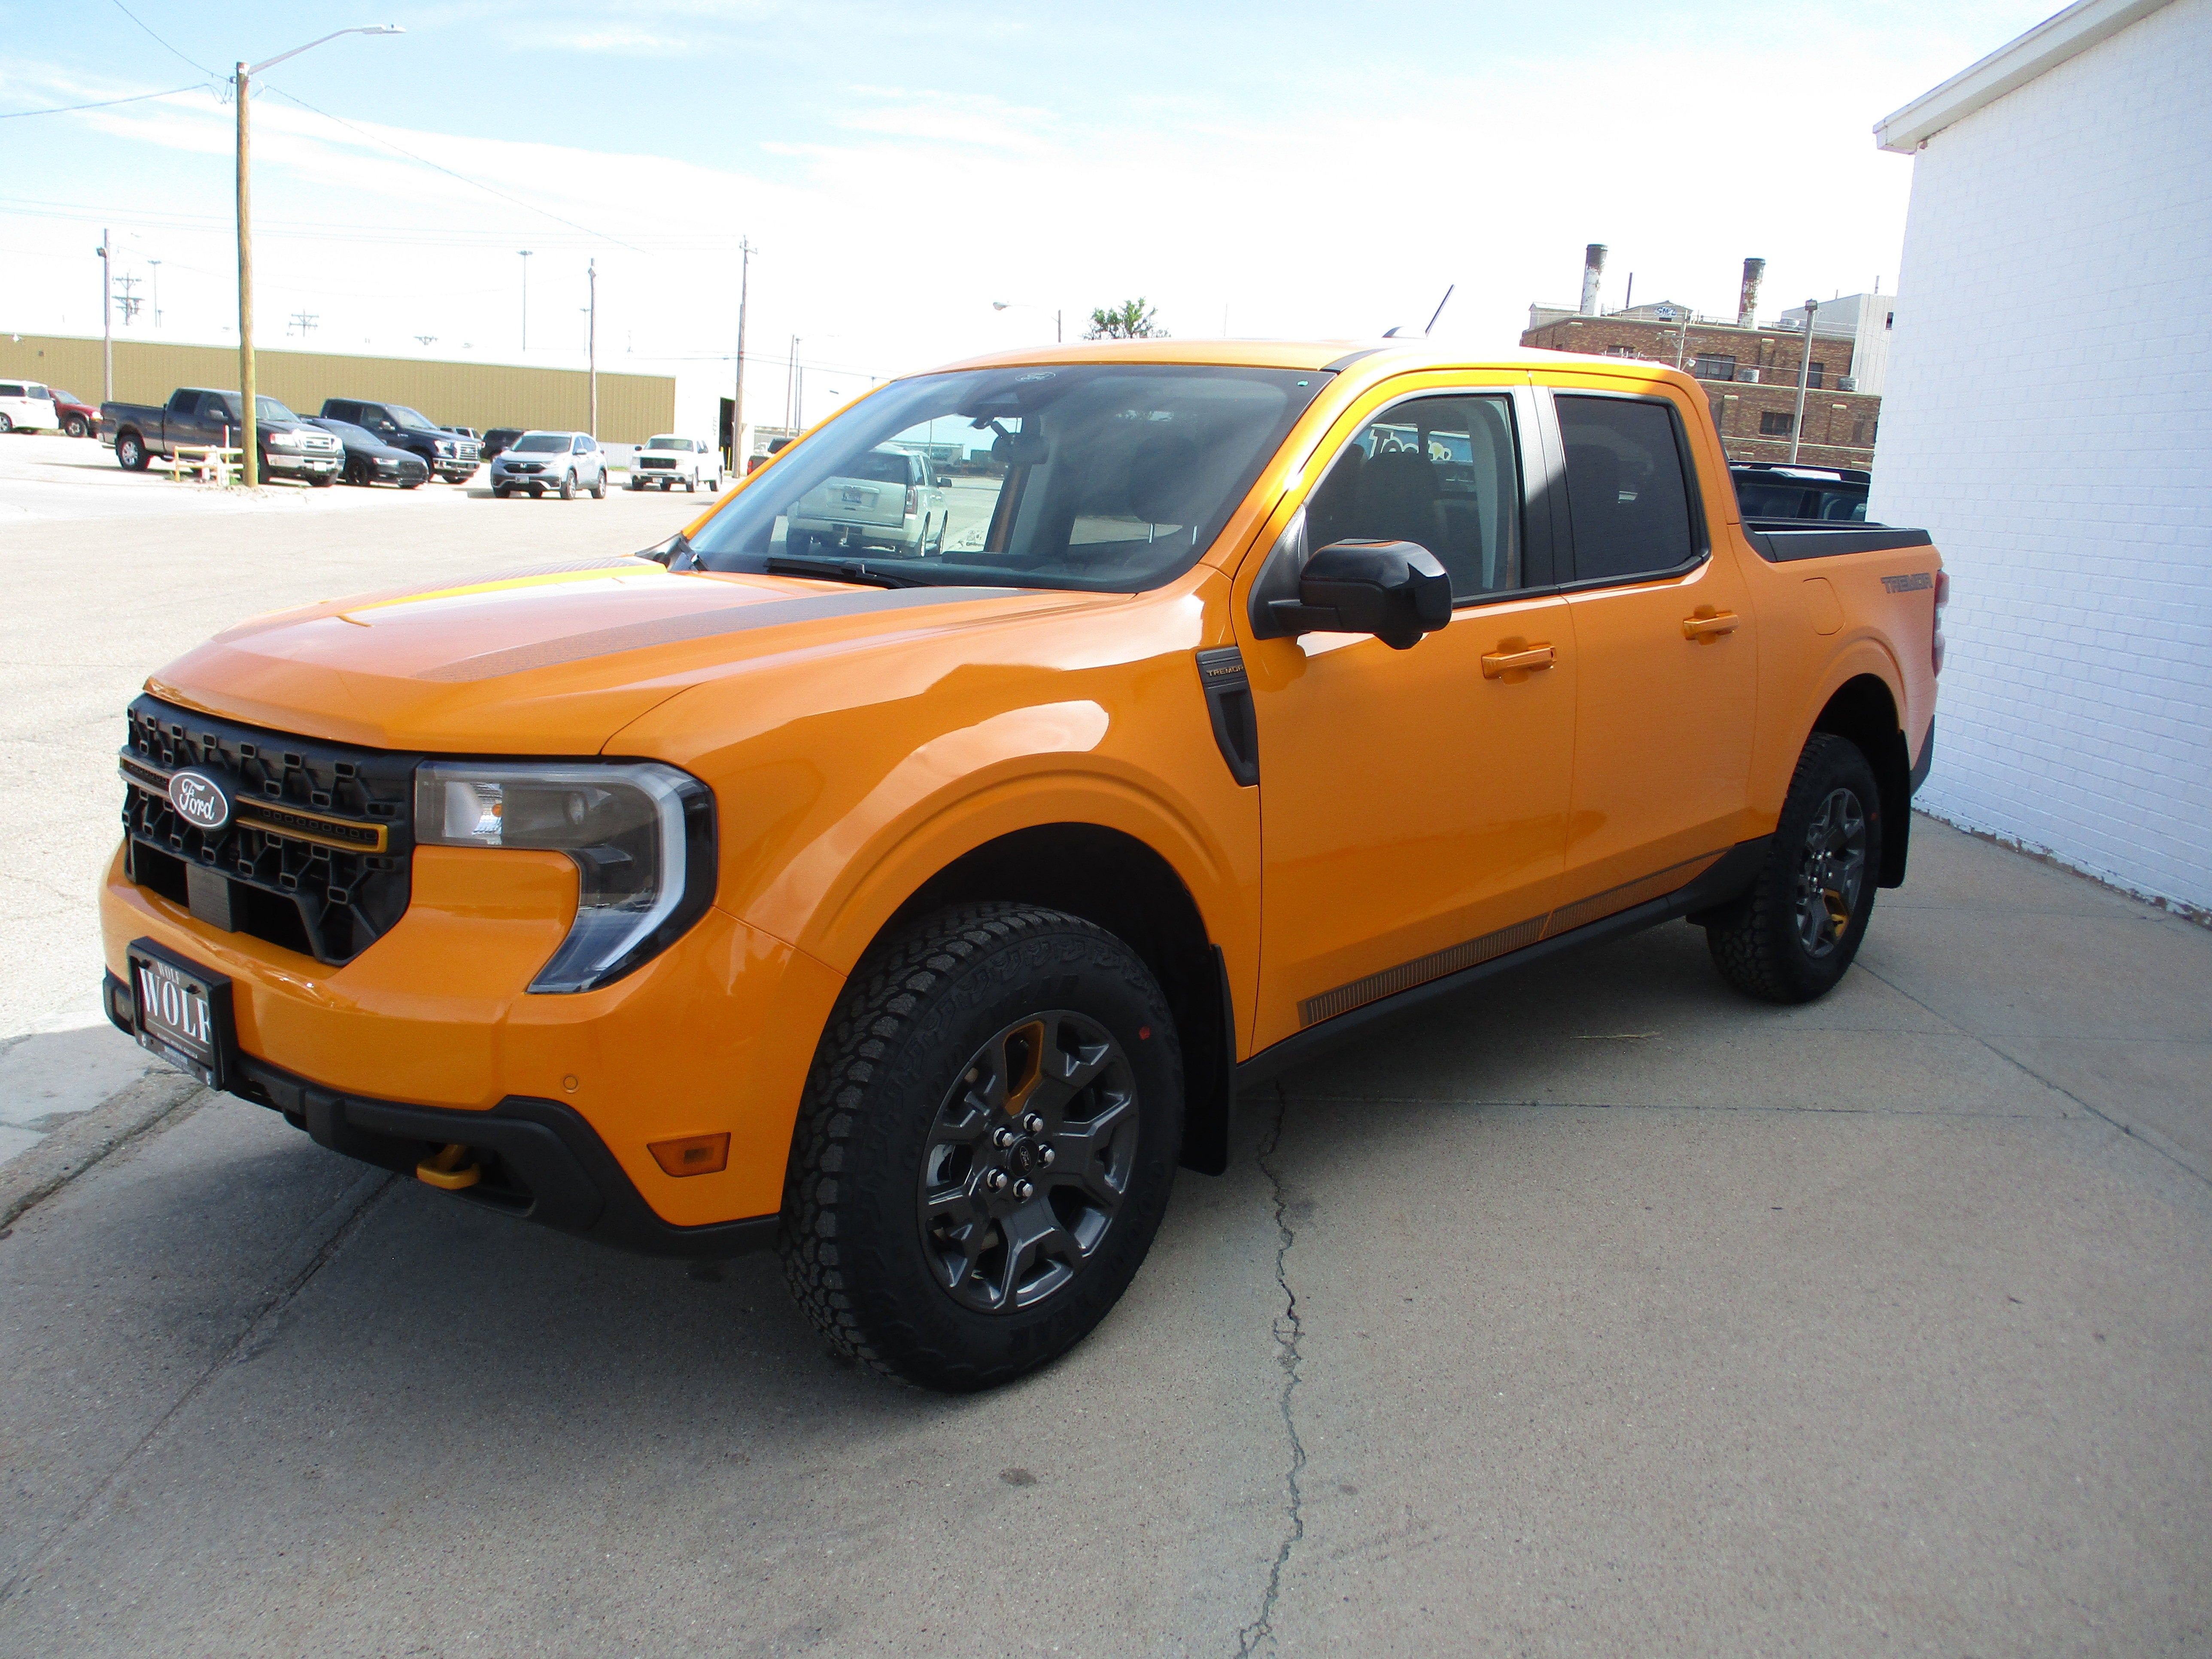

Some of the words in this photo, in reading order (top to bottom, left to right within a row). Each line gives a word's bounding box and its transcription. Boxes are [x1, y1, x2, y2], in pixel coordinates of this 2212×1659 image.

[1207, 665, 1244, 676] TREMOR
[179, 778, 215, 820] Ford
[139, 967, 210, 1044] WOLF
